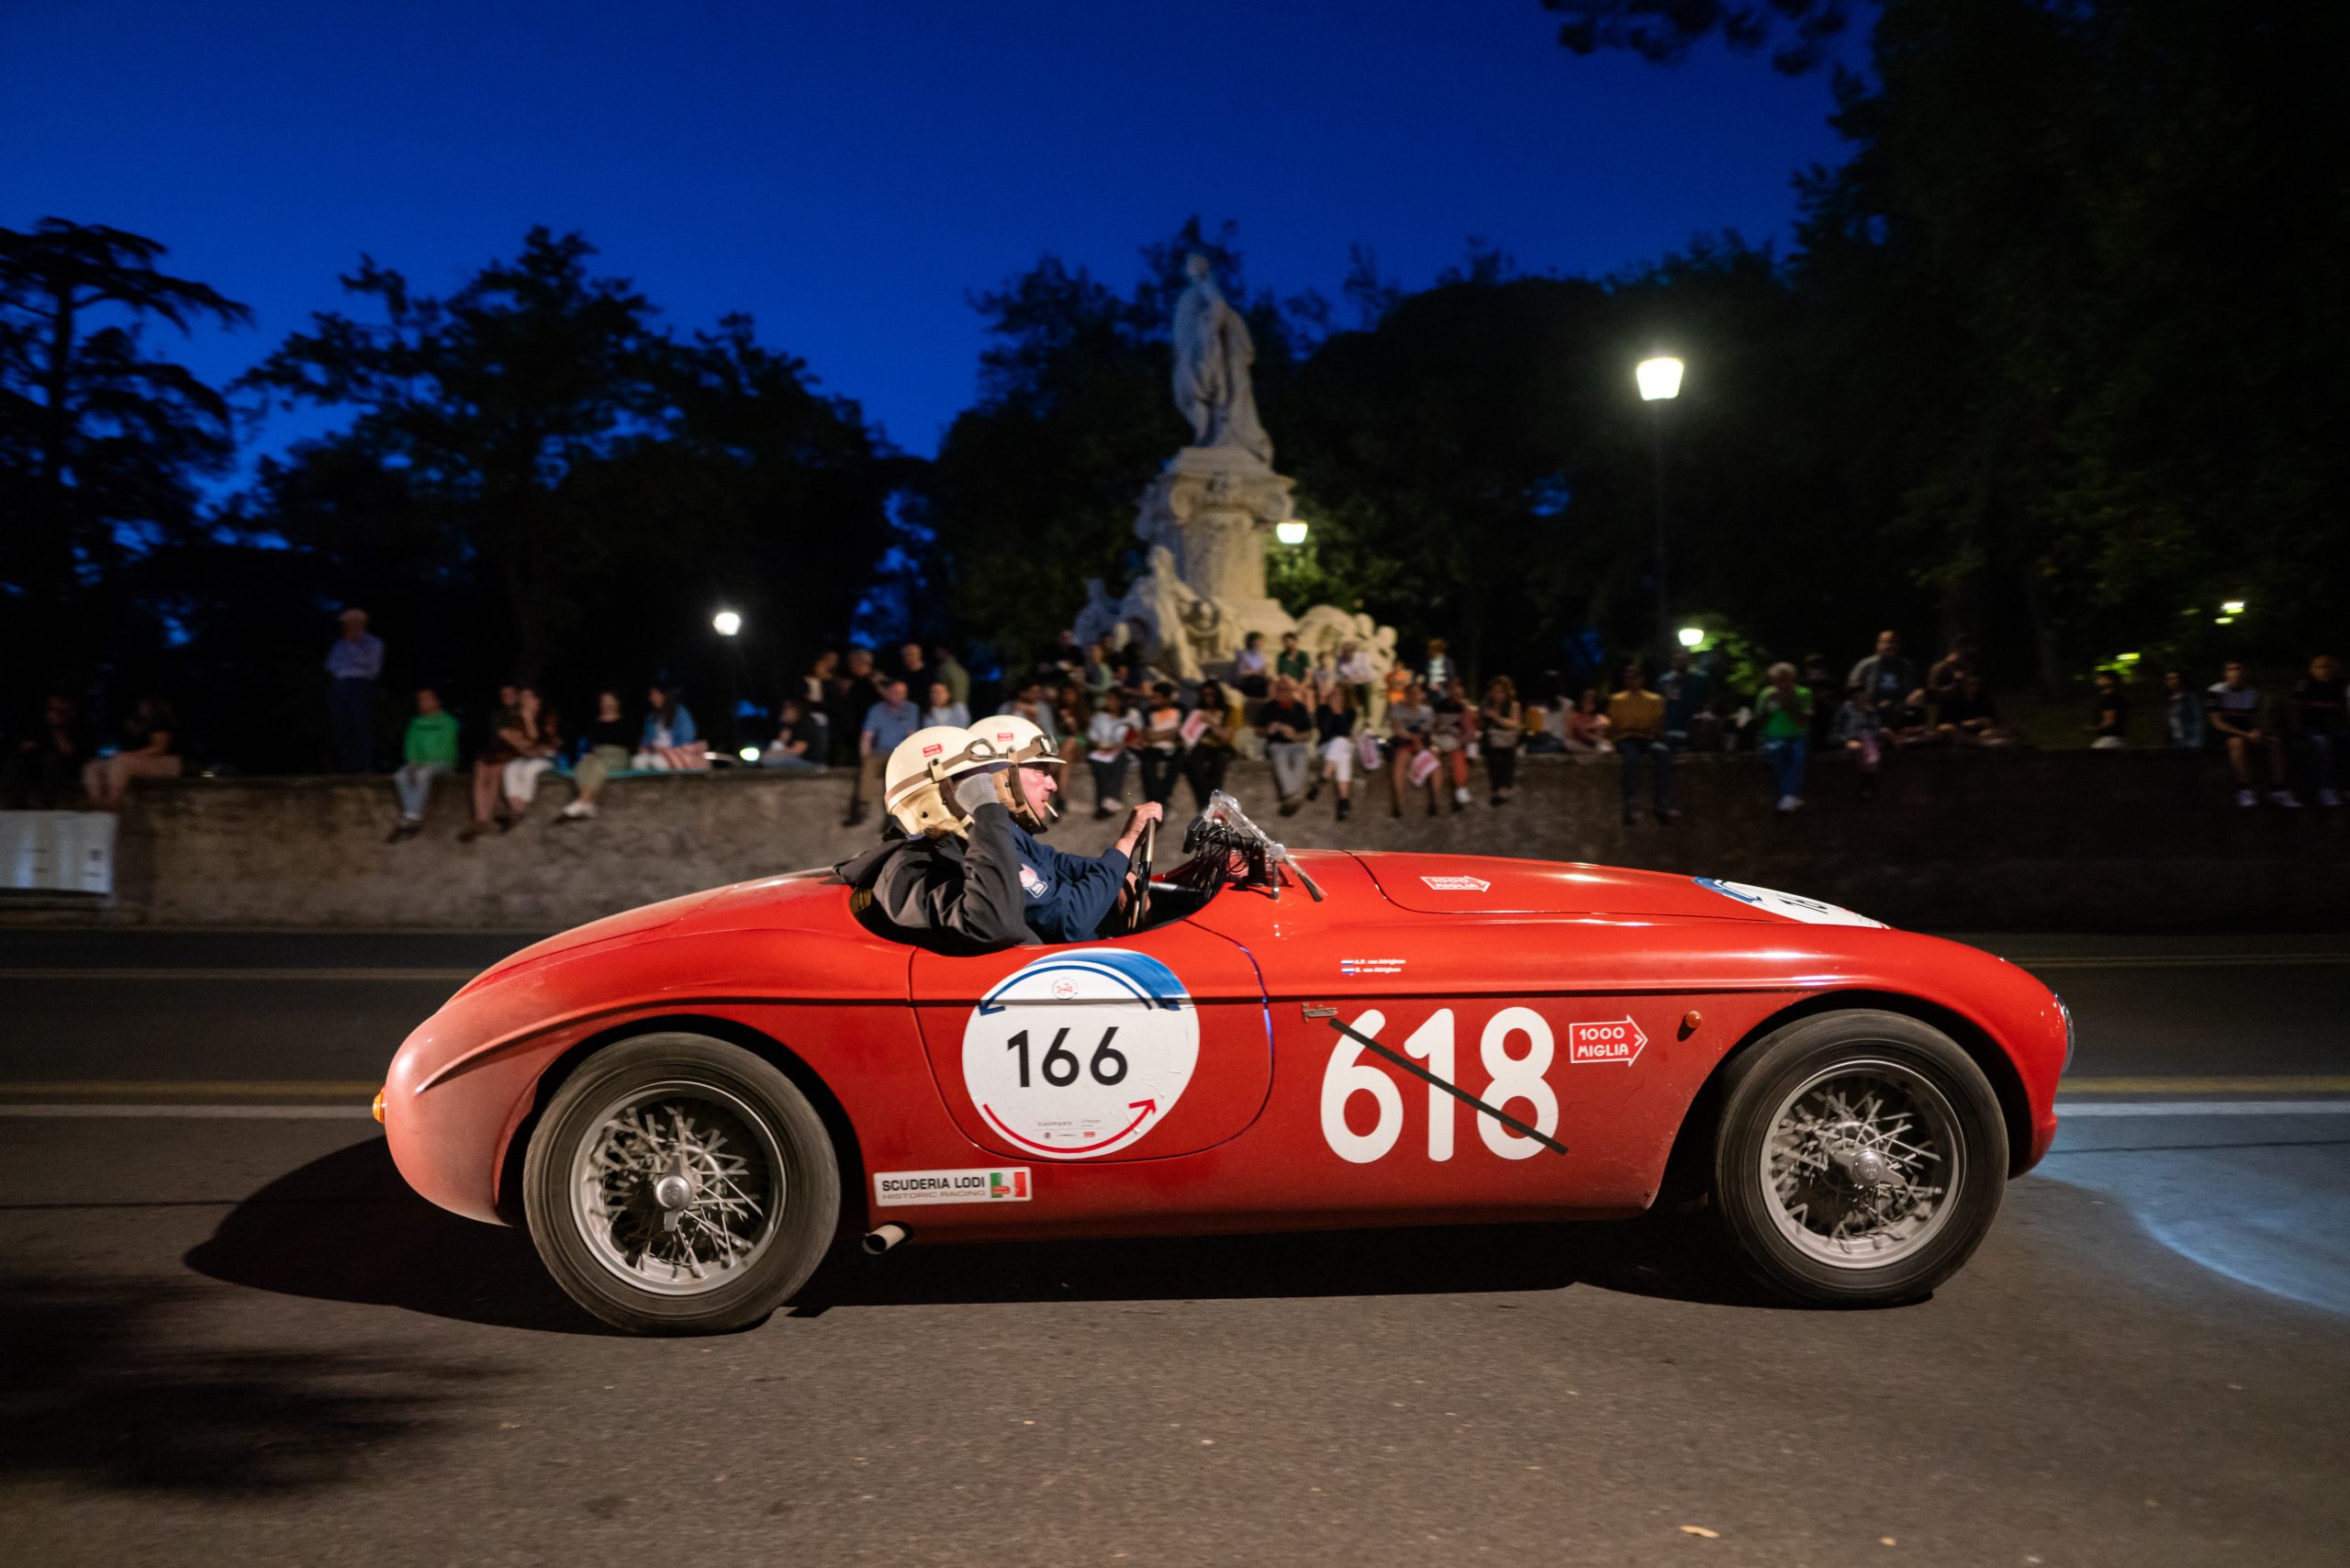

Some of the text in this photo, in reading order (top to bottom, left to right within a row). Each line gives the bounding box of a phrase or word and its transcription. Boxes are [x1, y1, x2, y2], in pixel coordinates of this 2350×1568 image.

[1579, 1027, 1625, 1042] 1000
[1007, 1025, 1128, 1088] 166
[1577, 1044, 1629, 1058] MIGLIA
[1320, 1006, 1560, 1164] 618
[881, 1176, 985, 1192] SCUDERIA LODI
[882, 1192, 937, 1200] HISTORIC
